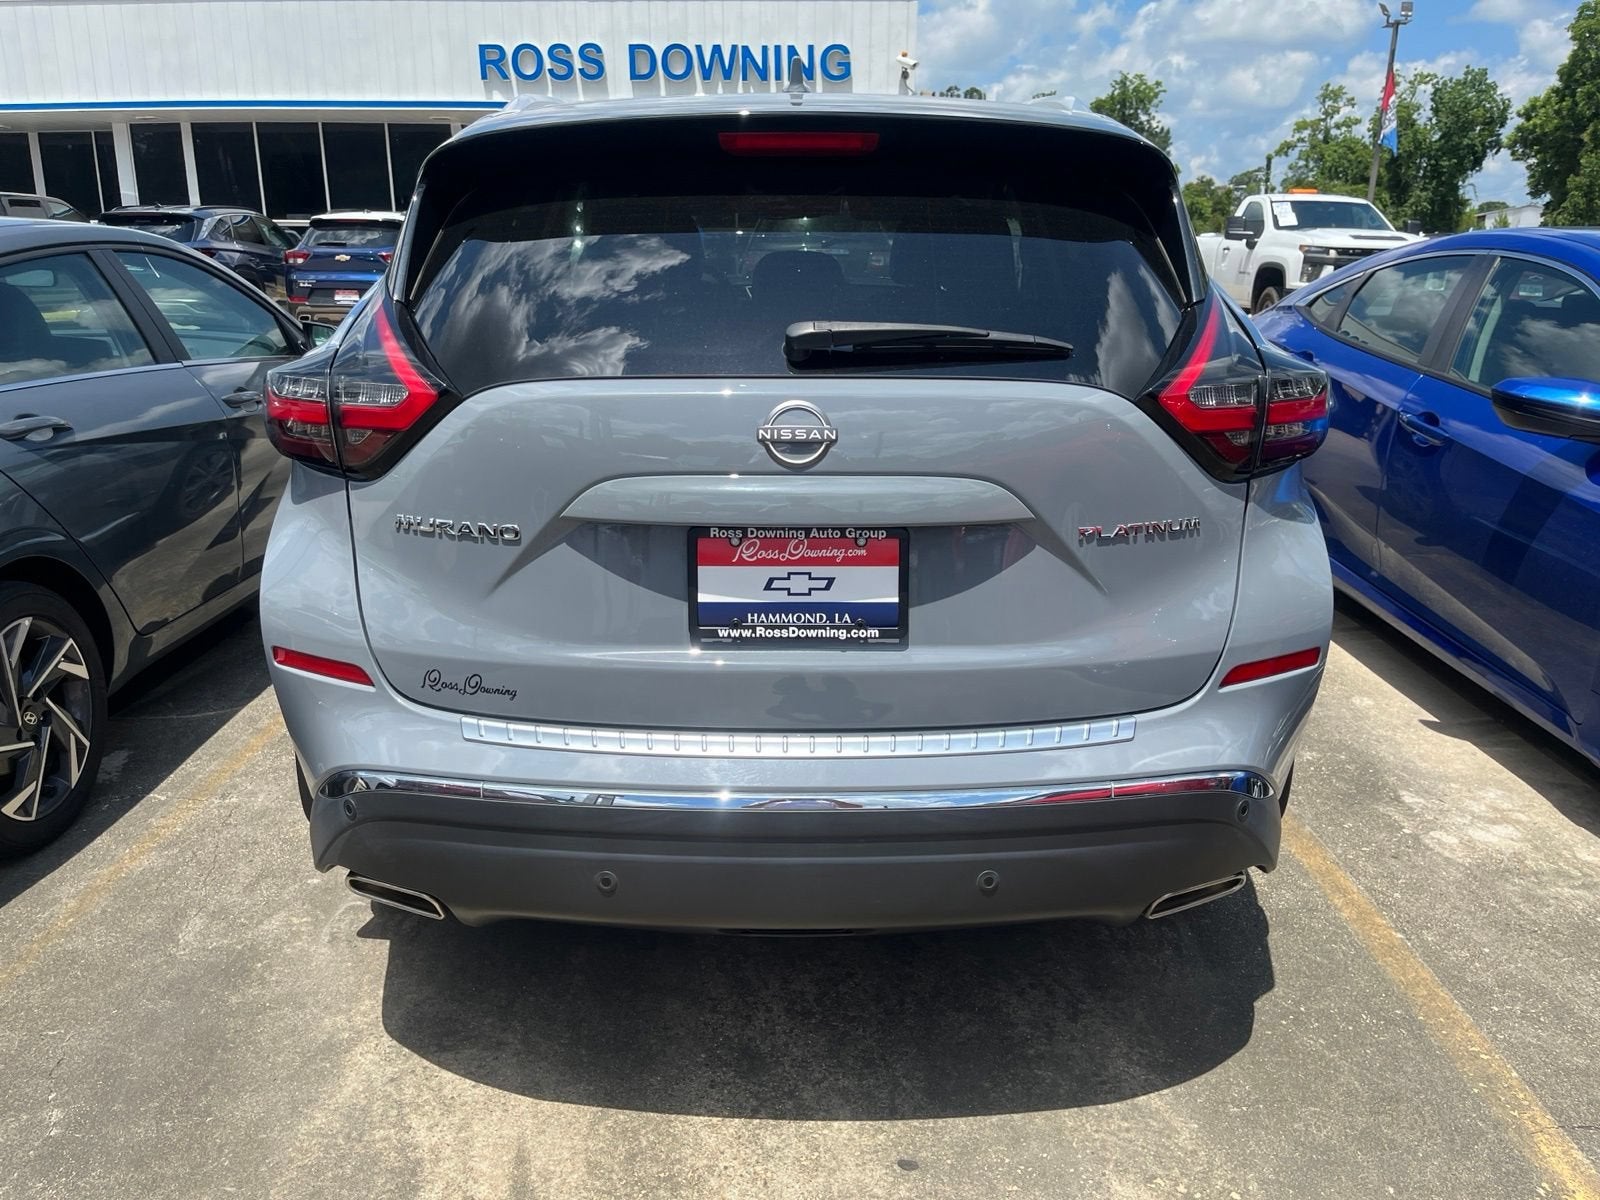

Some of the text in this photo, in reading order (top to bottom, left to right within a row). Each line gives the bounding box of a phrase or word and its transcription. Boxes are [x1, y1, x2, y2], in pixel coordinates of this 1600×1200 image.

[478, 43, 852, 82] ROSS DOWNING
[758, 429, 836, 440] NISSAN
[394, 513, 521, 541] MURANO
[710, 527, 887, 540] Ross Downing Auto Group
[1078, 516, 1200, 539] PLATINUM
[835, 613, 852, 624] LA
[717, 627, 880, 640] www.RossDowning.com
[421, 669, 518, 701] Ross Downing
